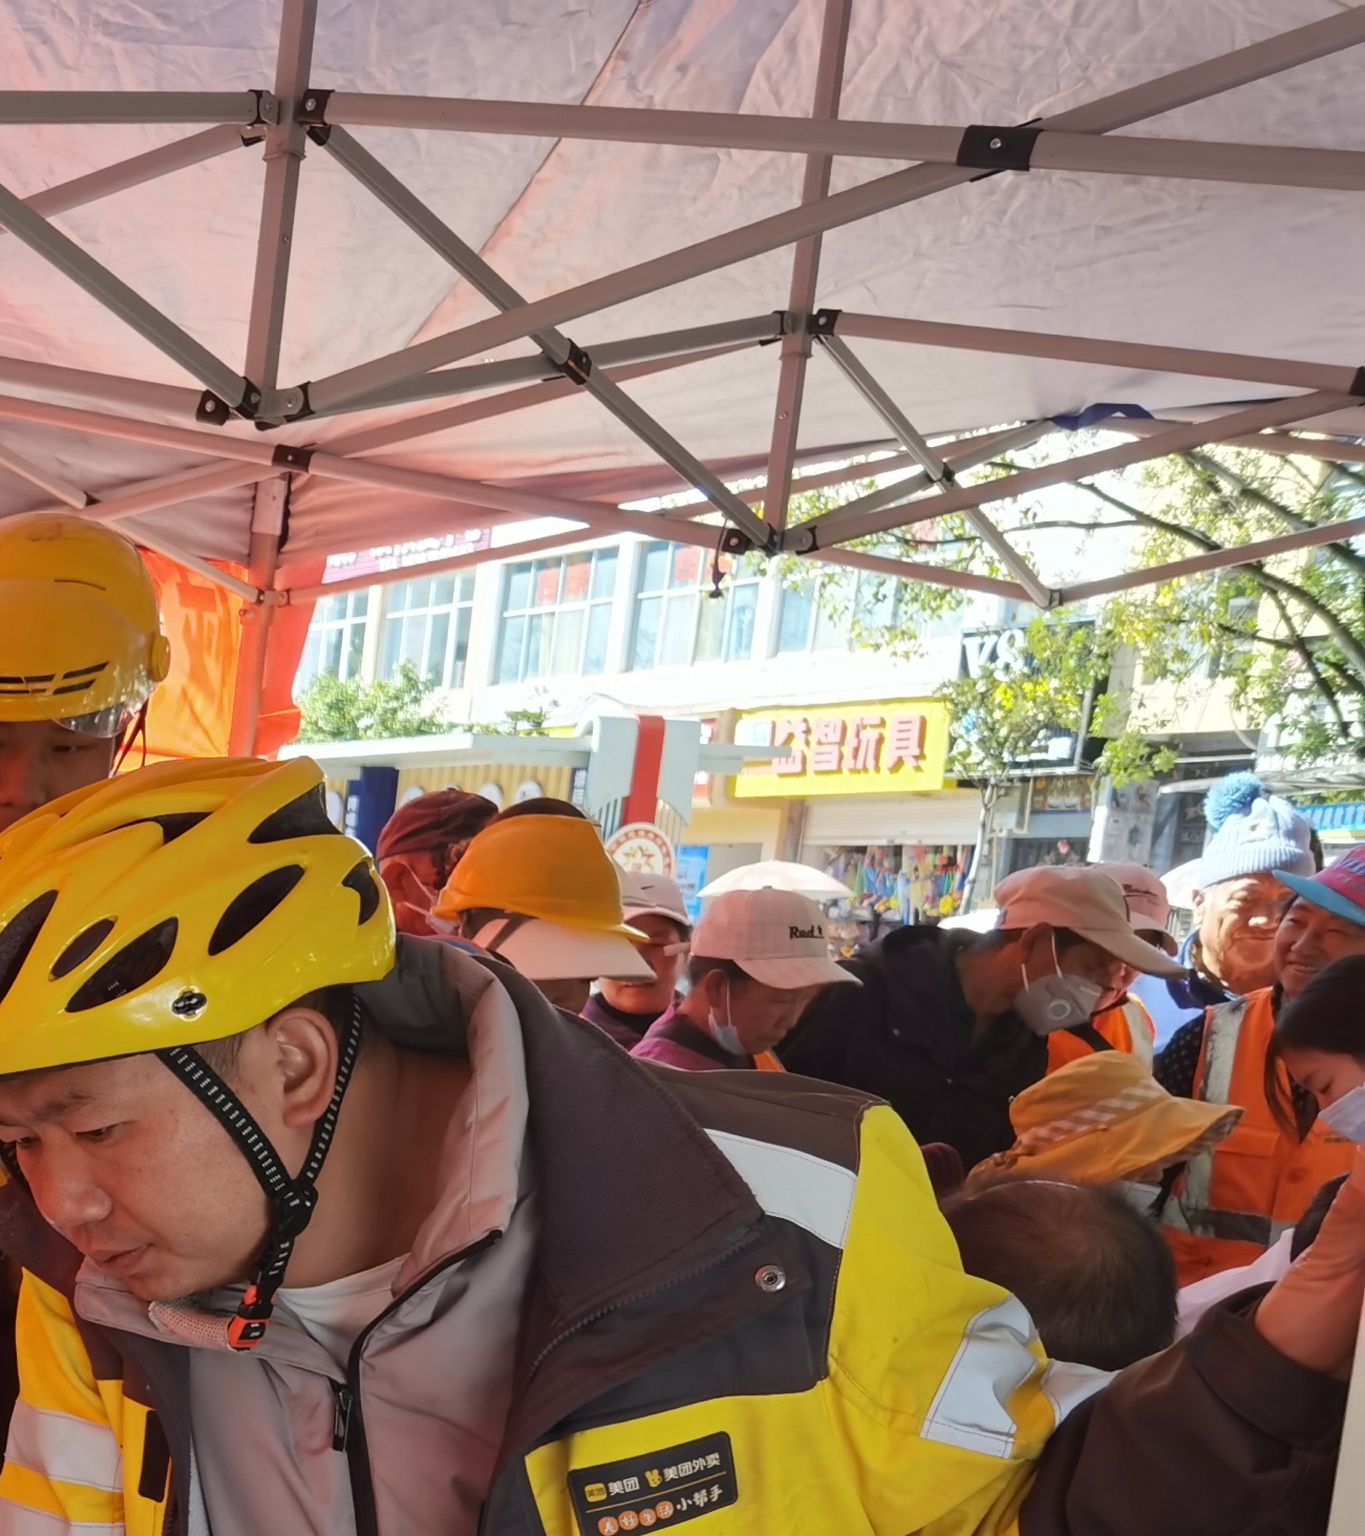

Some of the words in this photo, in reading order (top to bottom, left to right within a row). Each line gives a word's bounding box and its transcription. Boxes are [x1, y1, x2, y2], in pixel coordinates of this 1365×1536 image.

[774, 714, 926, 777] 益智玩具
[607, 1476, 640, 1496] 美团
[662, 1451, 721, 1482] 美团外卖
